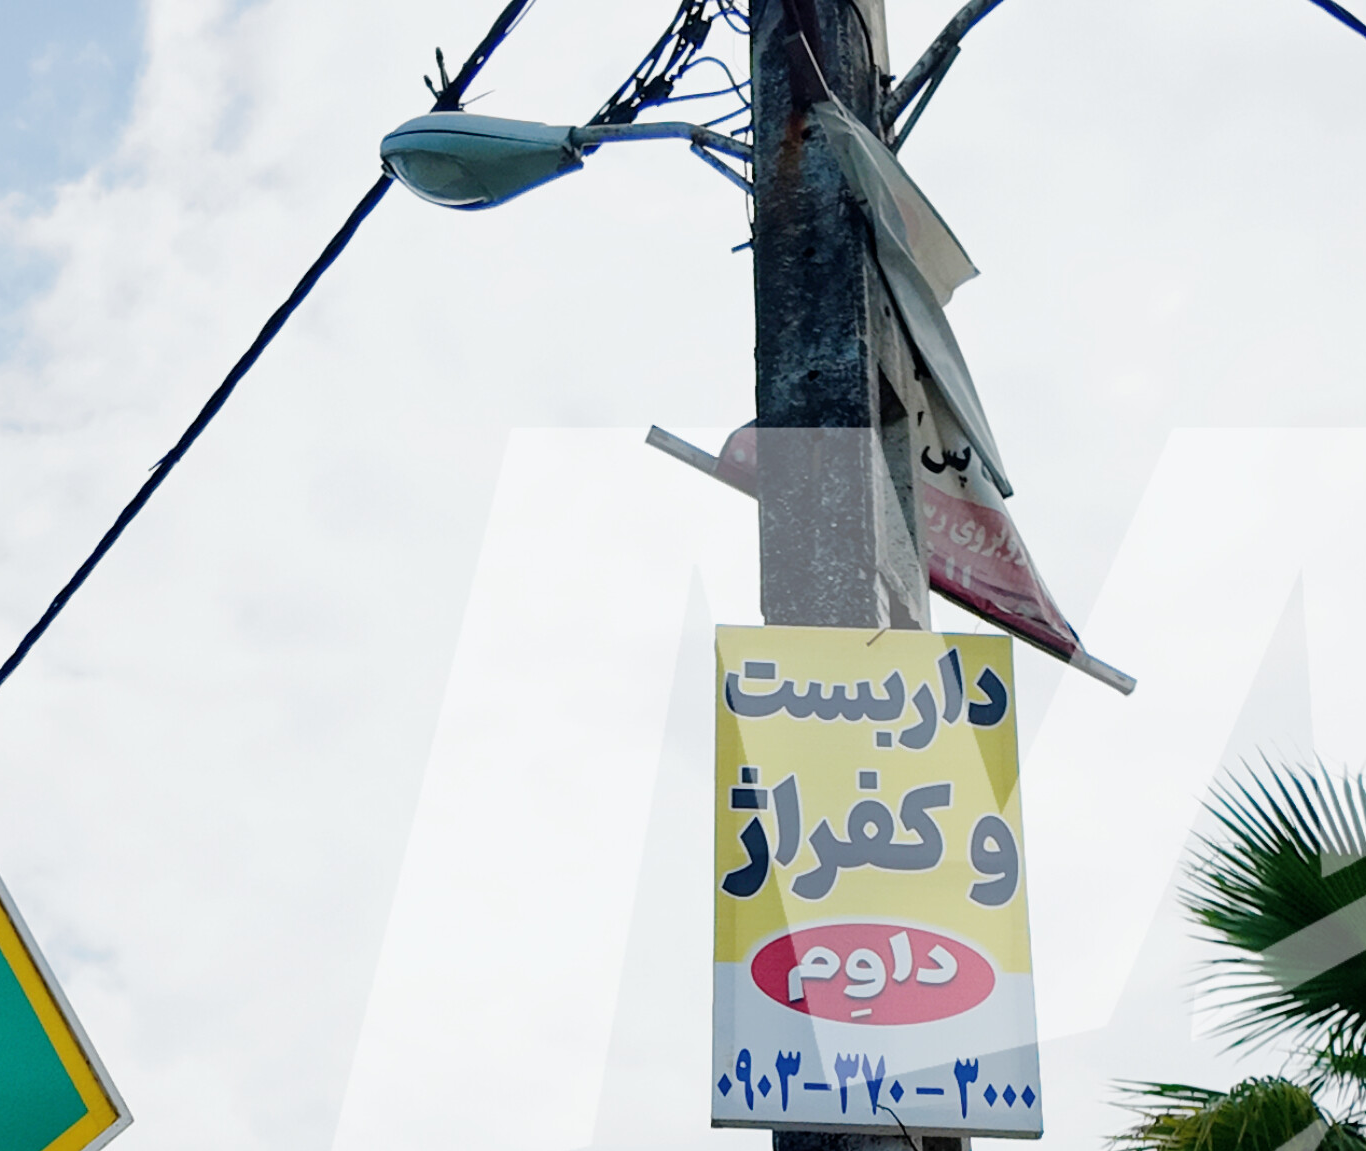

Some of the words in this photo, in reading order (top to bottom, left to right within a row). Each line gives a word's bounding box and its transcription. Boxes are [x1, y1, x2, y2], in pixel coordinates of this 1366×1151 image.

[724, 648, 1009, 751] داربست
[720, 765, 953, 901] کفراژ
[968, 812, 1021, 906] و
